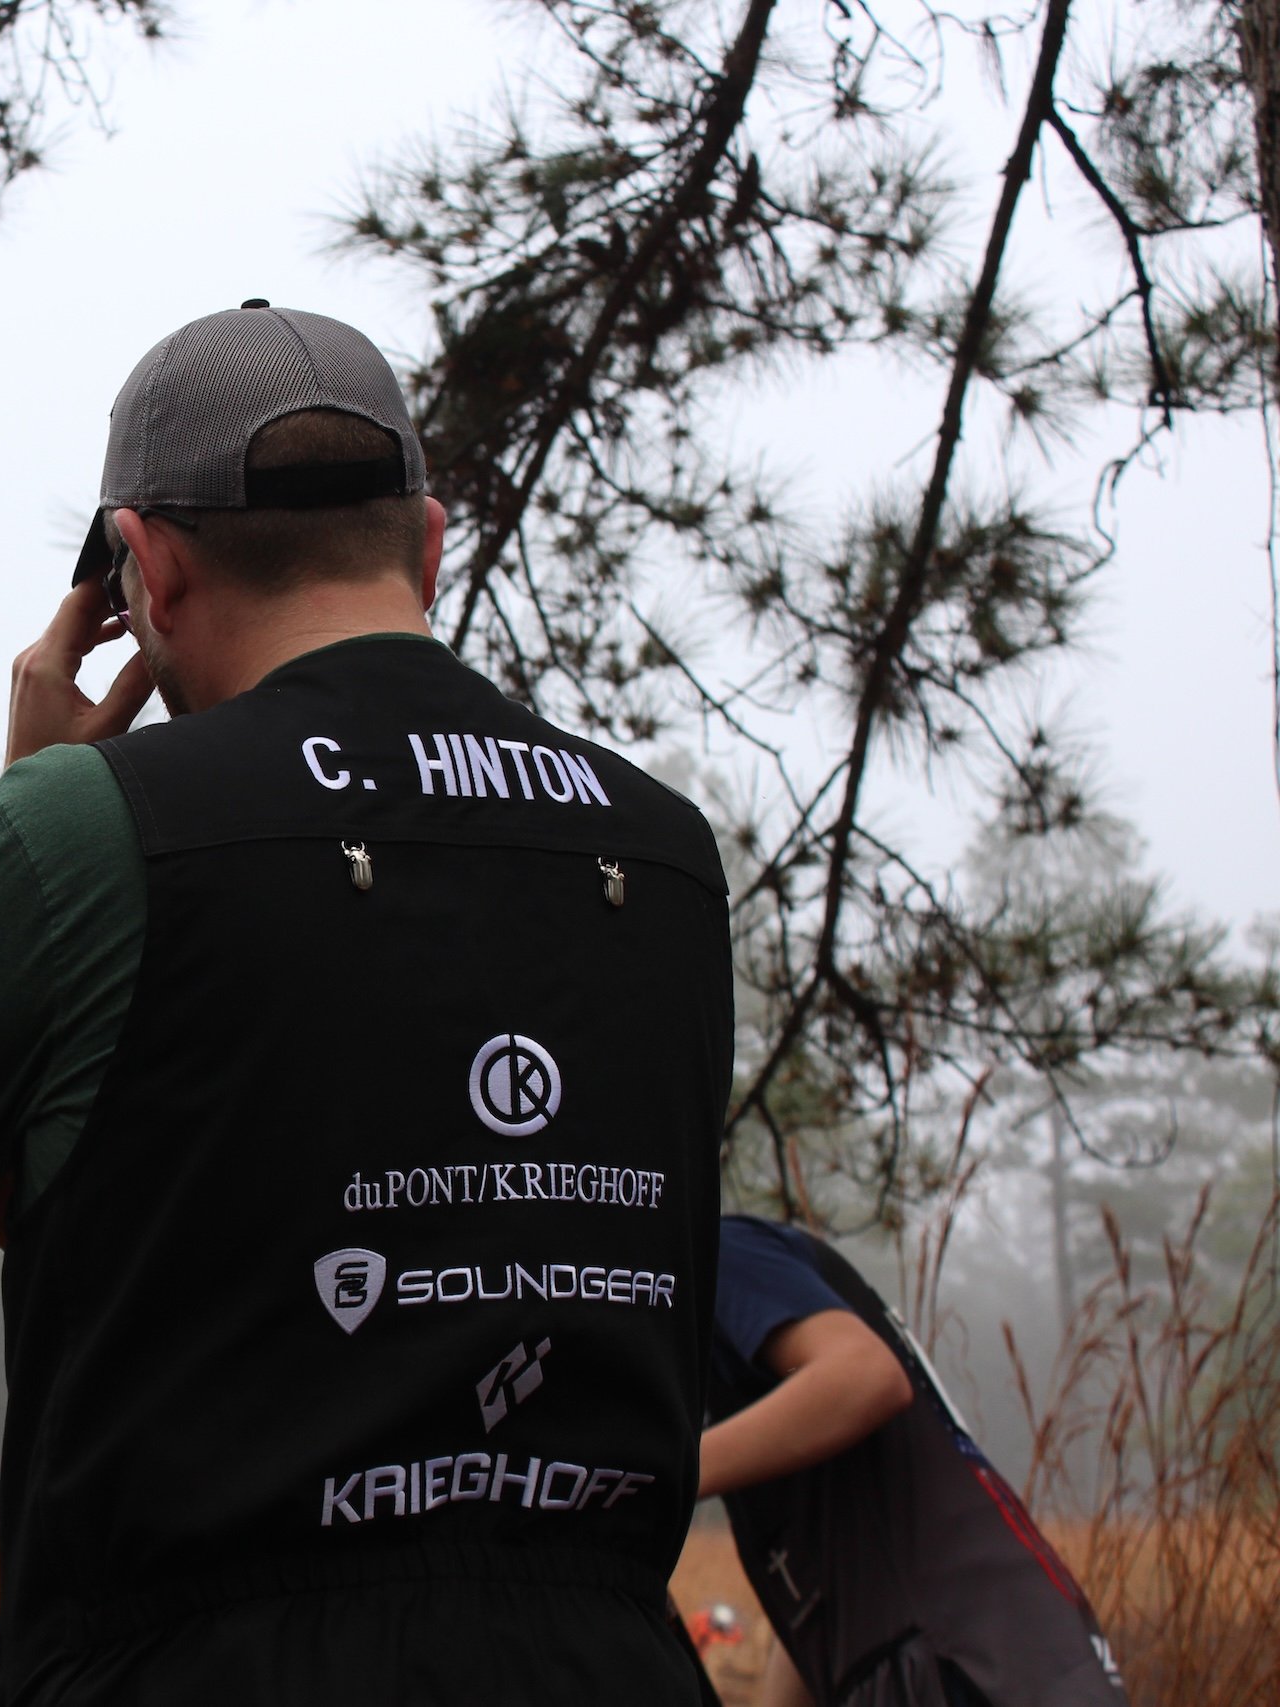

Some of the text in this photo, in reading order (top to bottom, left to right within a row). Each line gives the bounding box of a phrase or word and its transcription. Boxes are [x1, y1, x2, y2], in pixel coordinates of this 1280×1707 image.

[301, 734, 613, 807] C. HINTON
[343, 1162, 666, 1212] duPONT/KRIEGHOFF
[396, 1263, 677, 1309] SOUNDGEAR
[321, 1452, 656, 1527] KRIEGHOFF
